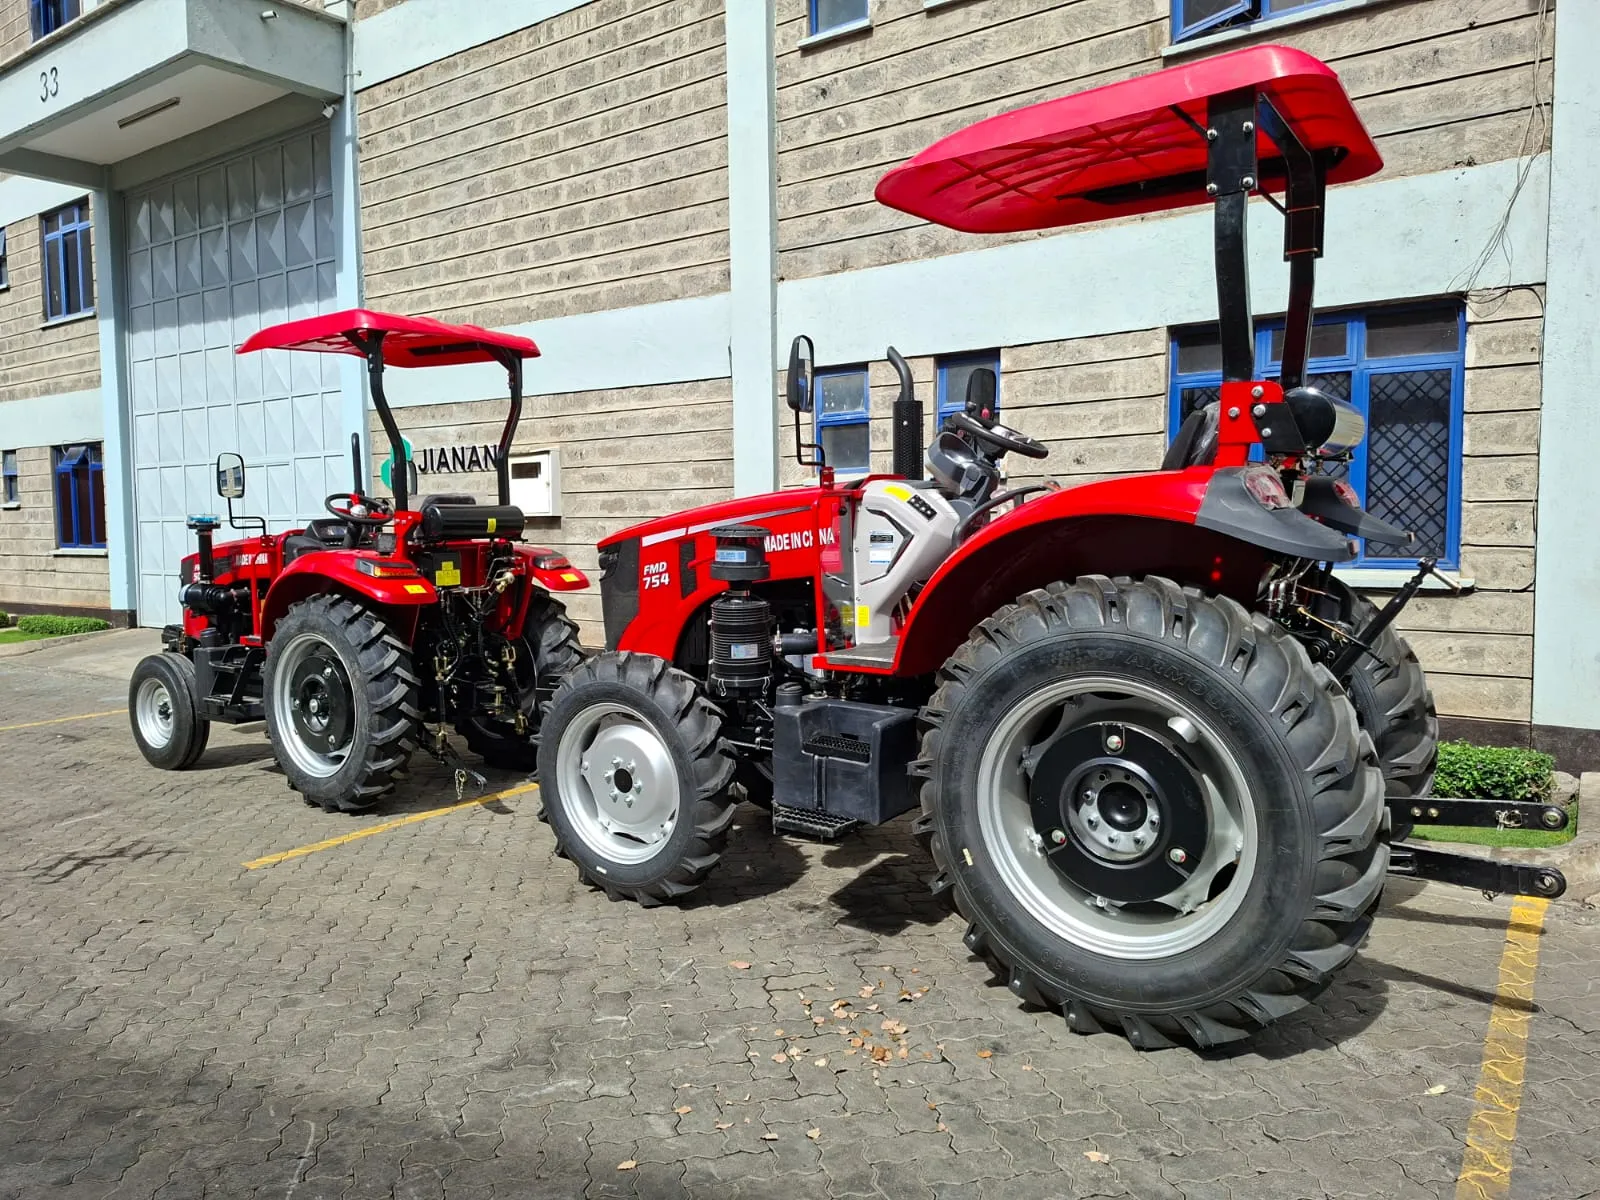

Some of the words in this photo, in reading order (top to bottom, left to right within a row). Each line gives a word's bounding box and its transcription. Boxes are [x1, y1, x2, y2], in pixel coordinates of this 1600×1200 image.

[40, 66, 59, 103] 33
[418, 444, 498, 472] JIANAN
[763, 533, 791, 553] MADE
[790, 531, 802, 549] IN
[802, 527, 835, 547] CNA
[642, 572, 670, 590] 754
[643, 561, 667, 576] FMD
